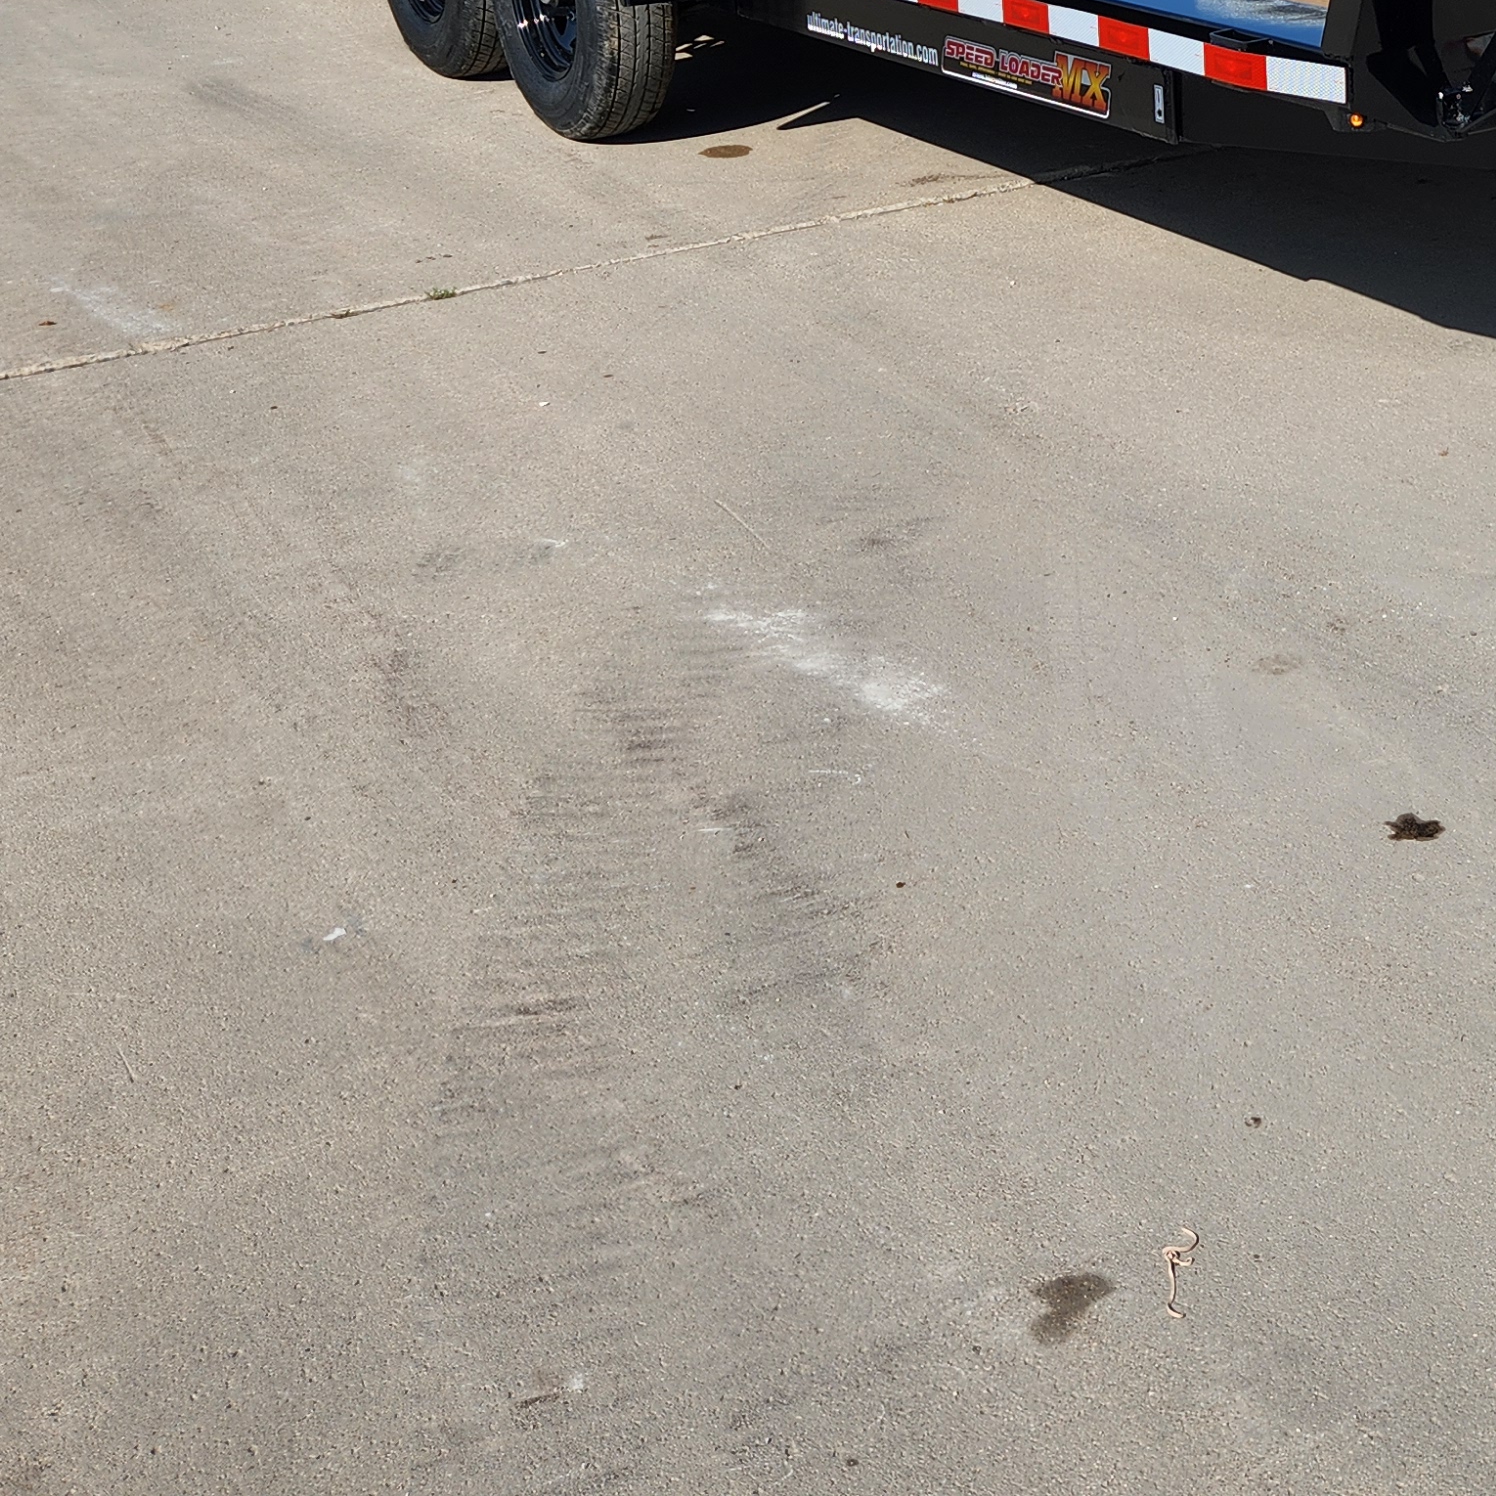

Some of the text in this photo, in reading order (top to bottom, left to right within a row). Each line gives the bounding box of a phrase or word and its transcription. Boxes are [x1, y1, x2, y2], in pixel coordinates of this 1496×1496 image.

[807, 11, 939, 66] ultimate-transportation.com
[945, 39, 995, 68] SPEED
[1000, 50, 1064, 86] LOADER
[1052, 52, 1111, 111] MX
